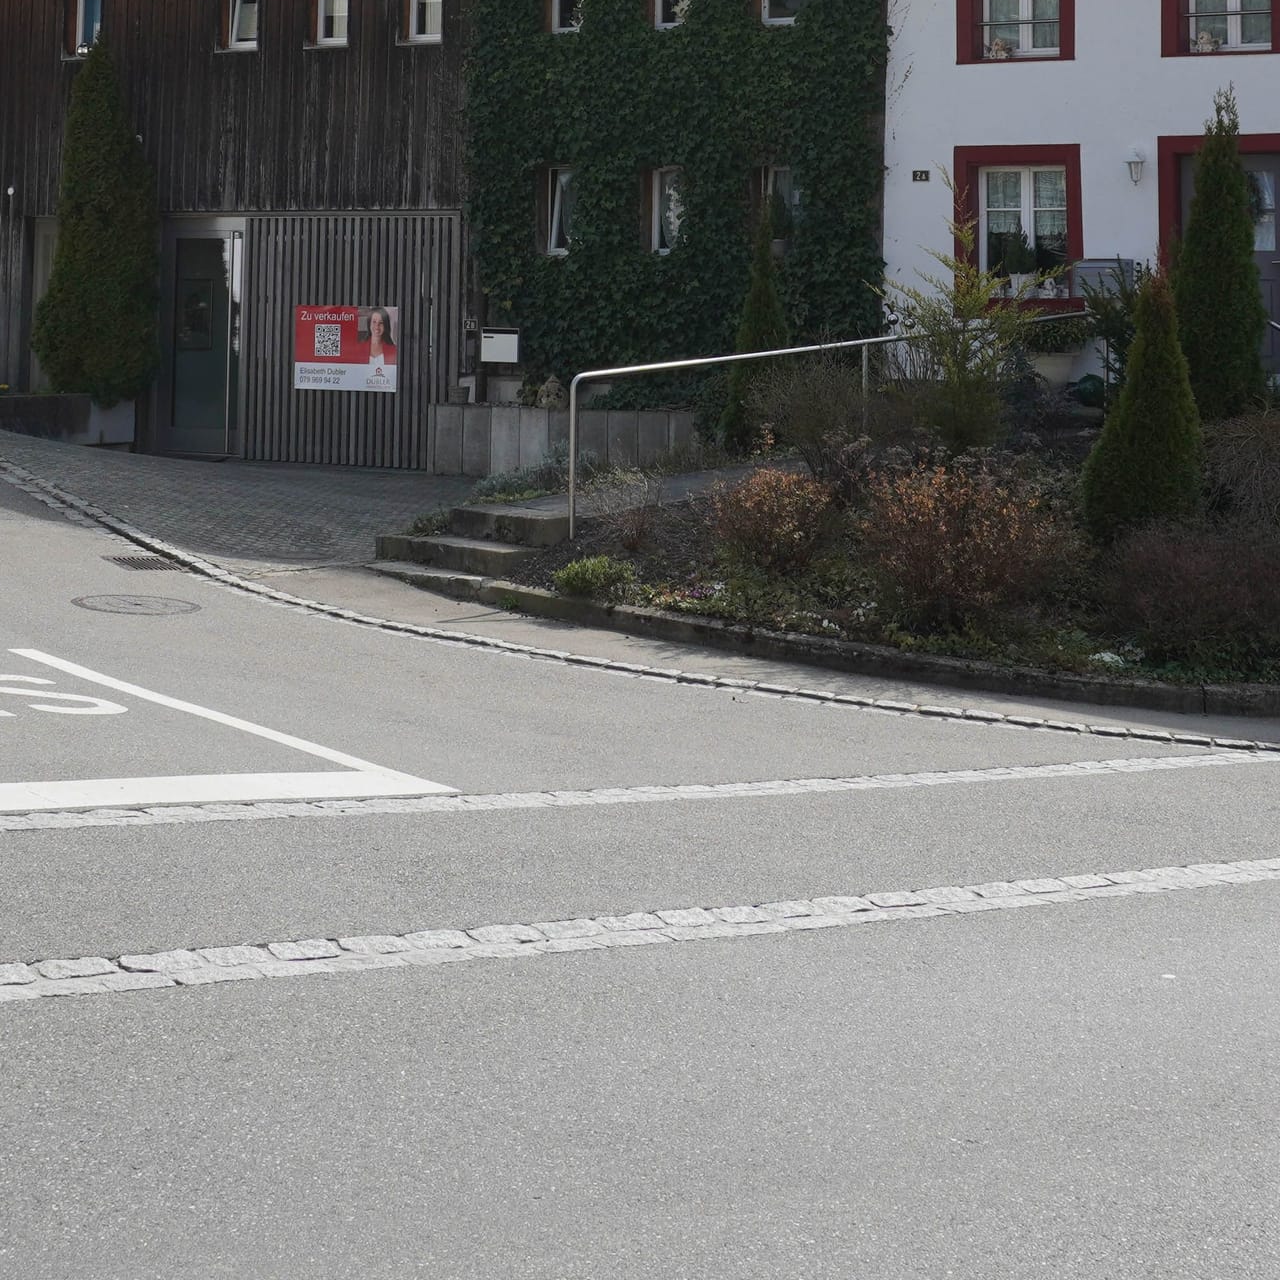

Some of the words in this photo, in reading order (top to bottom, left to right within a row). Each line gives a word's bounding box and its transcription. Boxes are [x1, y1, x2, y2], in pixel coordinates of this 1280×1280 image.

[300, 310, 312, 321] Zu
[314, 311, 355, 321] verkaufen
[299, 367, 326, 376] Elisabeth
[327, 367, 347, 376] Dubler
[299, 376, 311, 384] 079
[332, 377, 341, 385] 22
